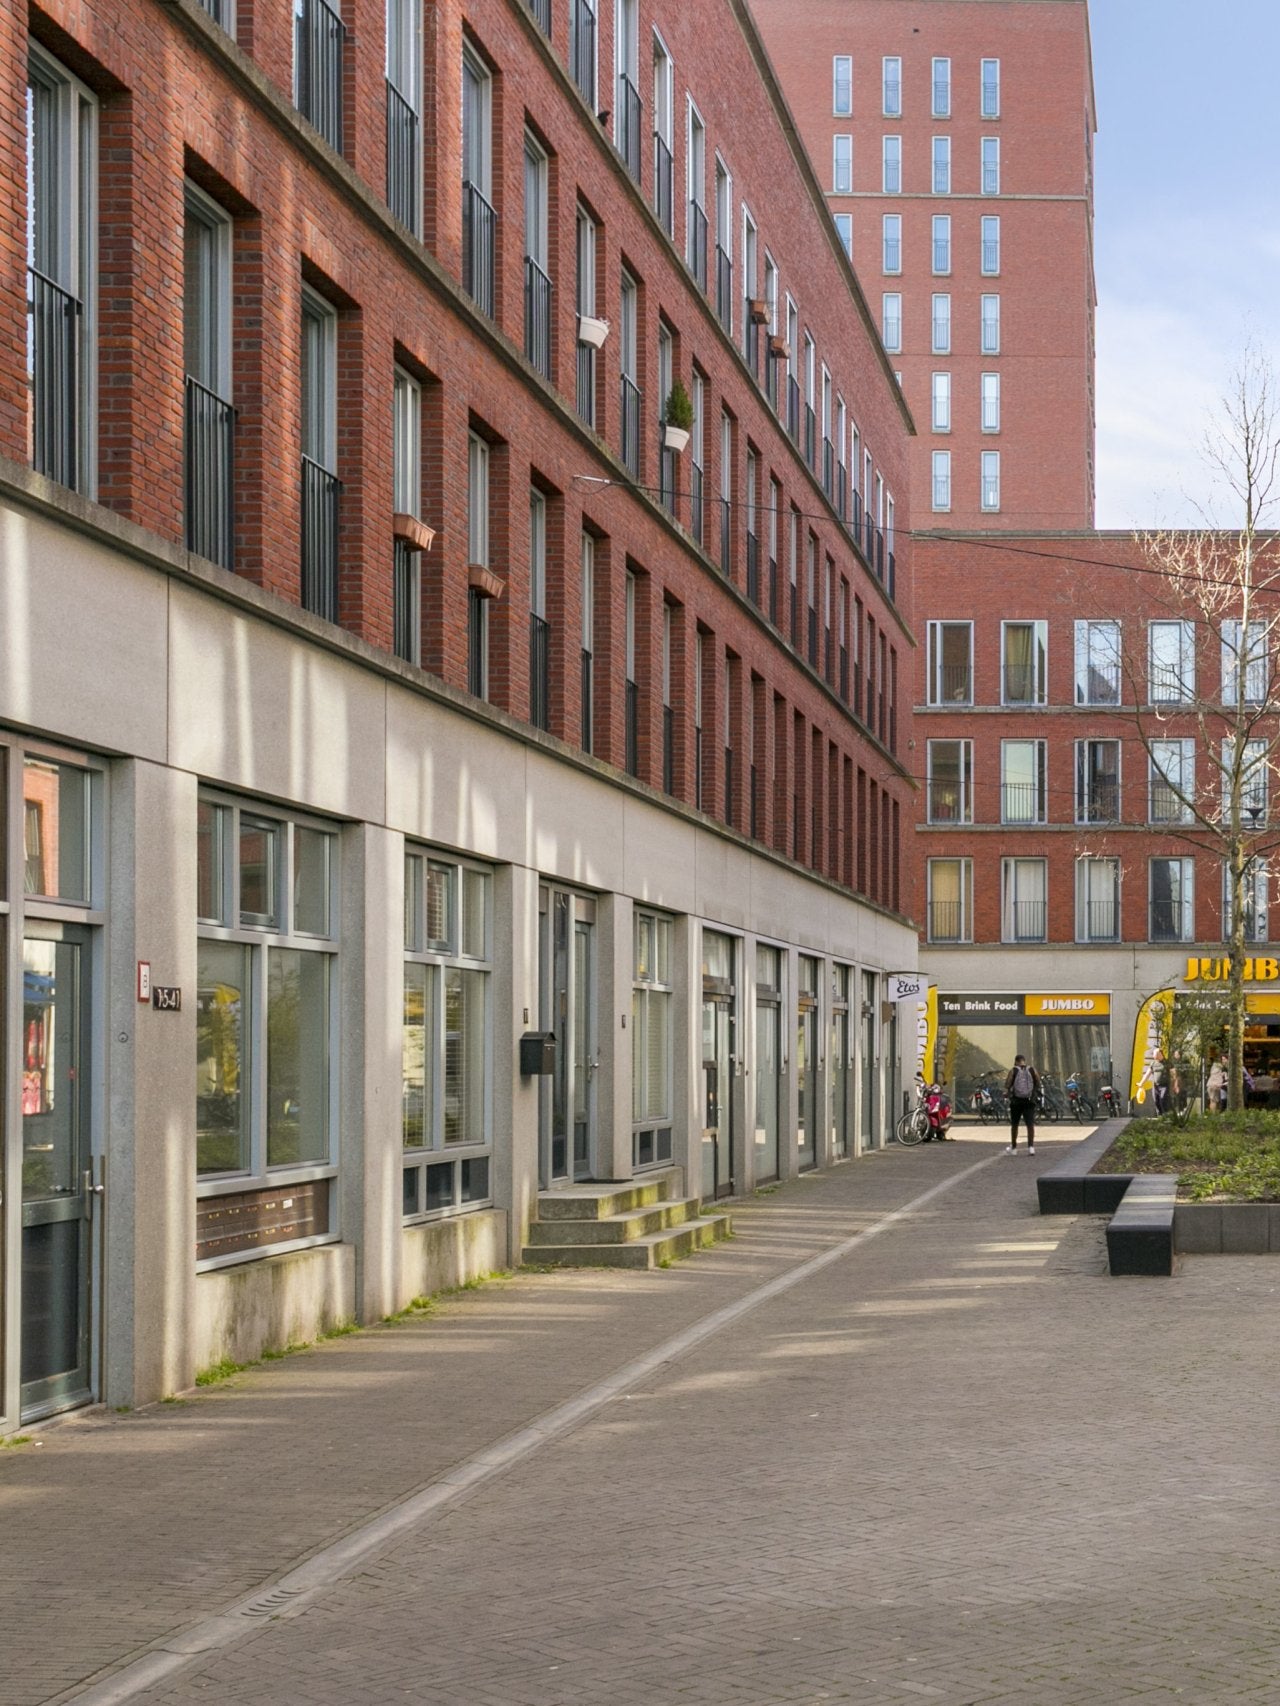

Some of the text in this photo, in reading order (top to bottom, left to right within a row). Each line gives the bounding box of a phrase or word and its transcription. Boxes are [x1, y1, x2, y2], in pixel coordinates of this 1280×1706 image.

[897, 980, 920, 997] Etos
[943, 1001, 1018, 1011] Ten Brink Food
[1041, 999, 1095, 1010] JUMBO
